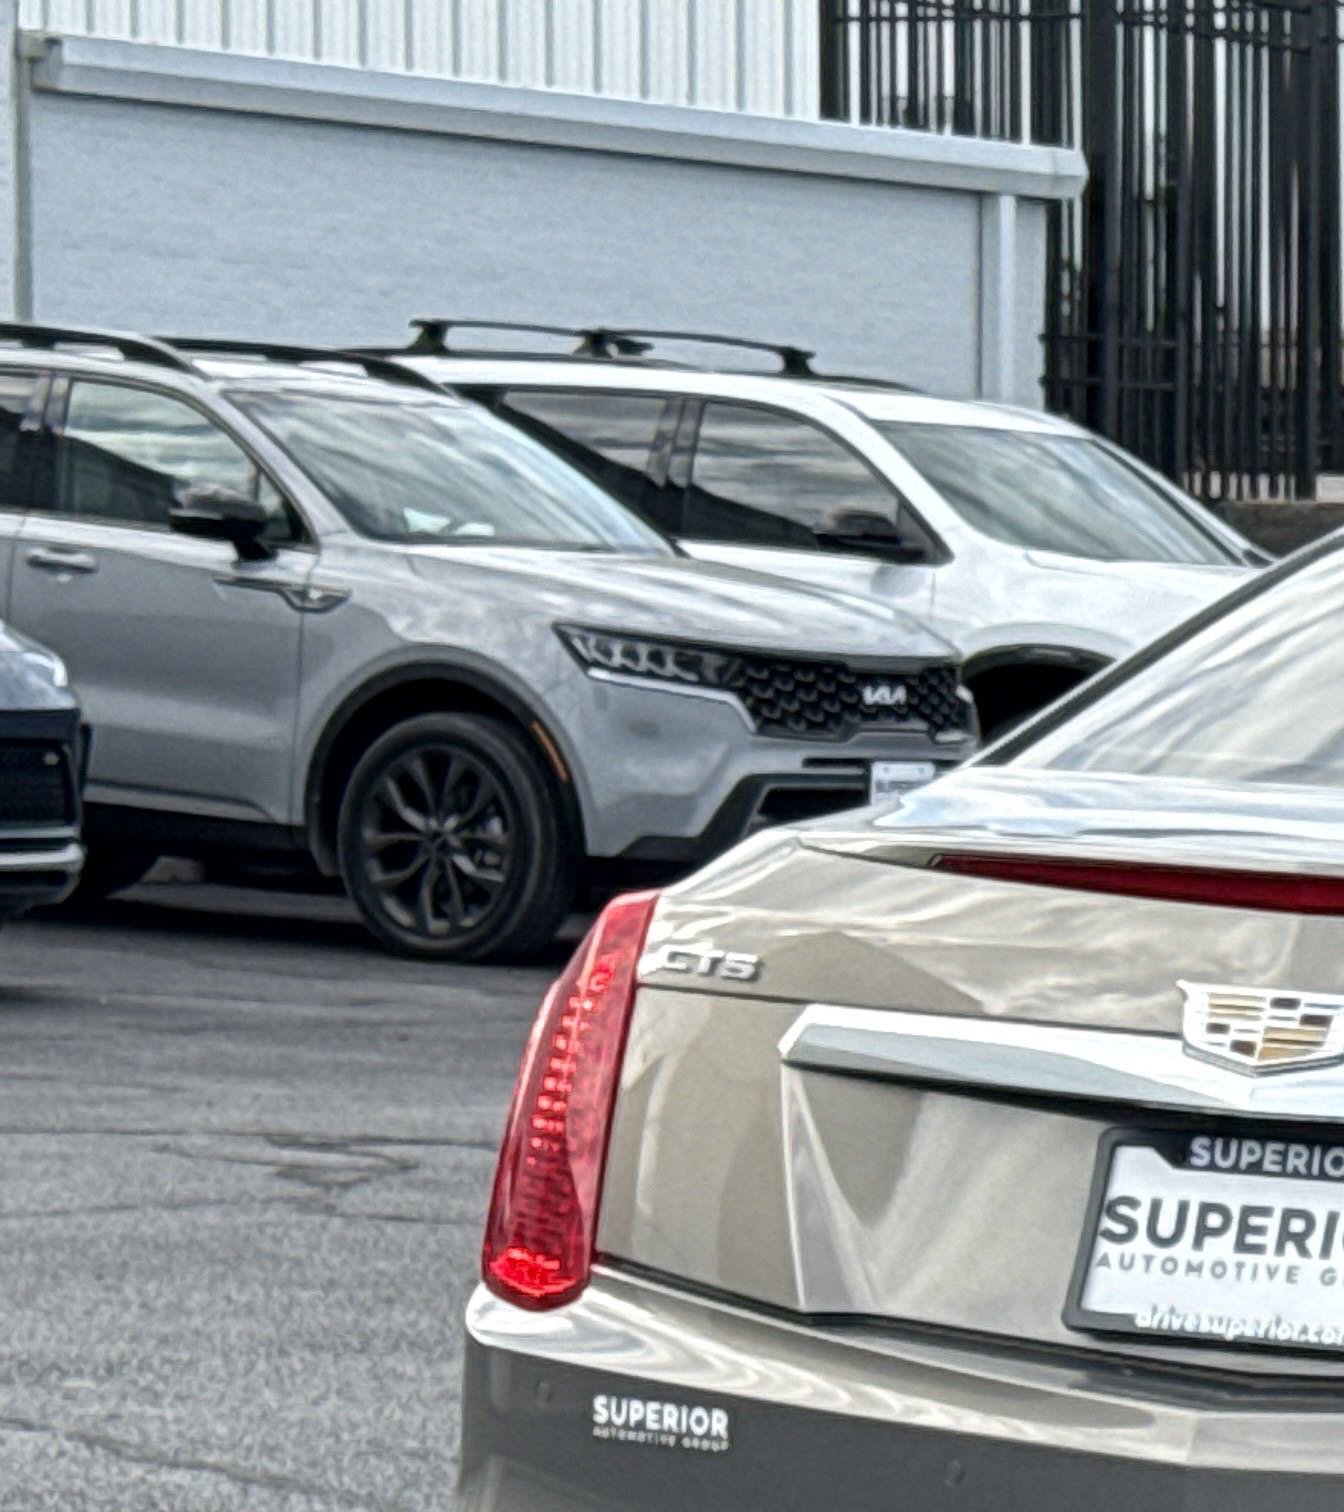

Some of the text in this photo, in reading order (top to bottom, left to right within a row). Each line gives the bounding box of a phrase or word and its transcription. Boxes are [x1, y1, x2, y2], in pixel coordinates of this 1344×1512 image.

[658, 944, 758, 979] CTS
[1097, 1252, 1300, 1284] AUTOMOTIVE
[592, 1395, 729, 1439] SUPERIOR
